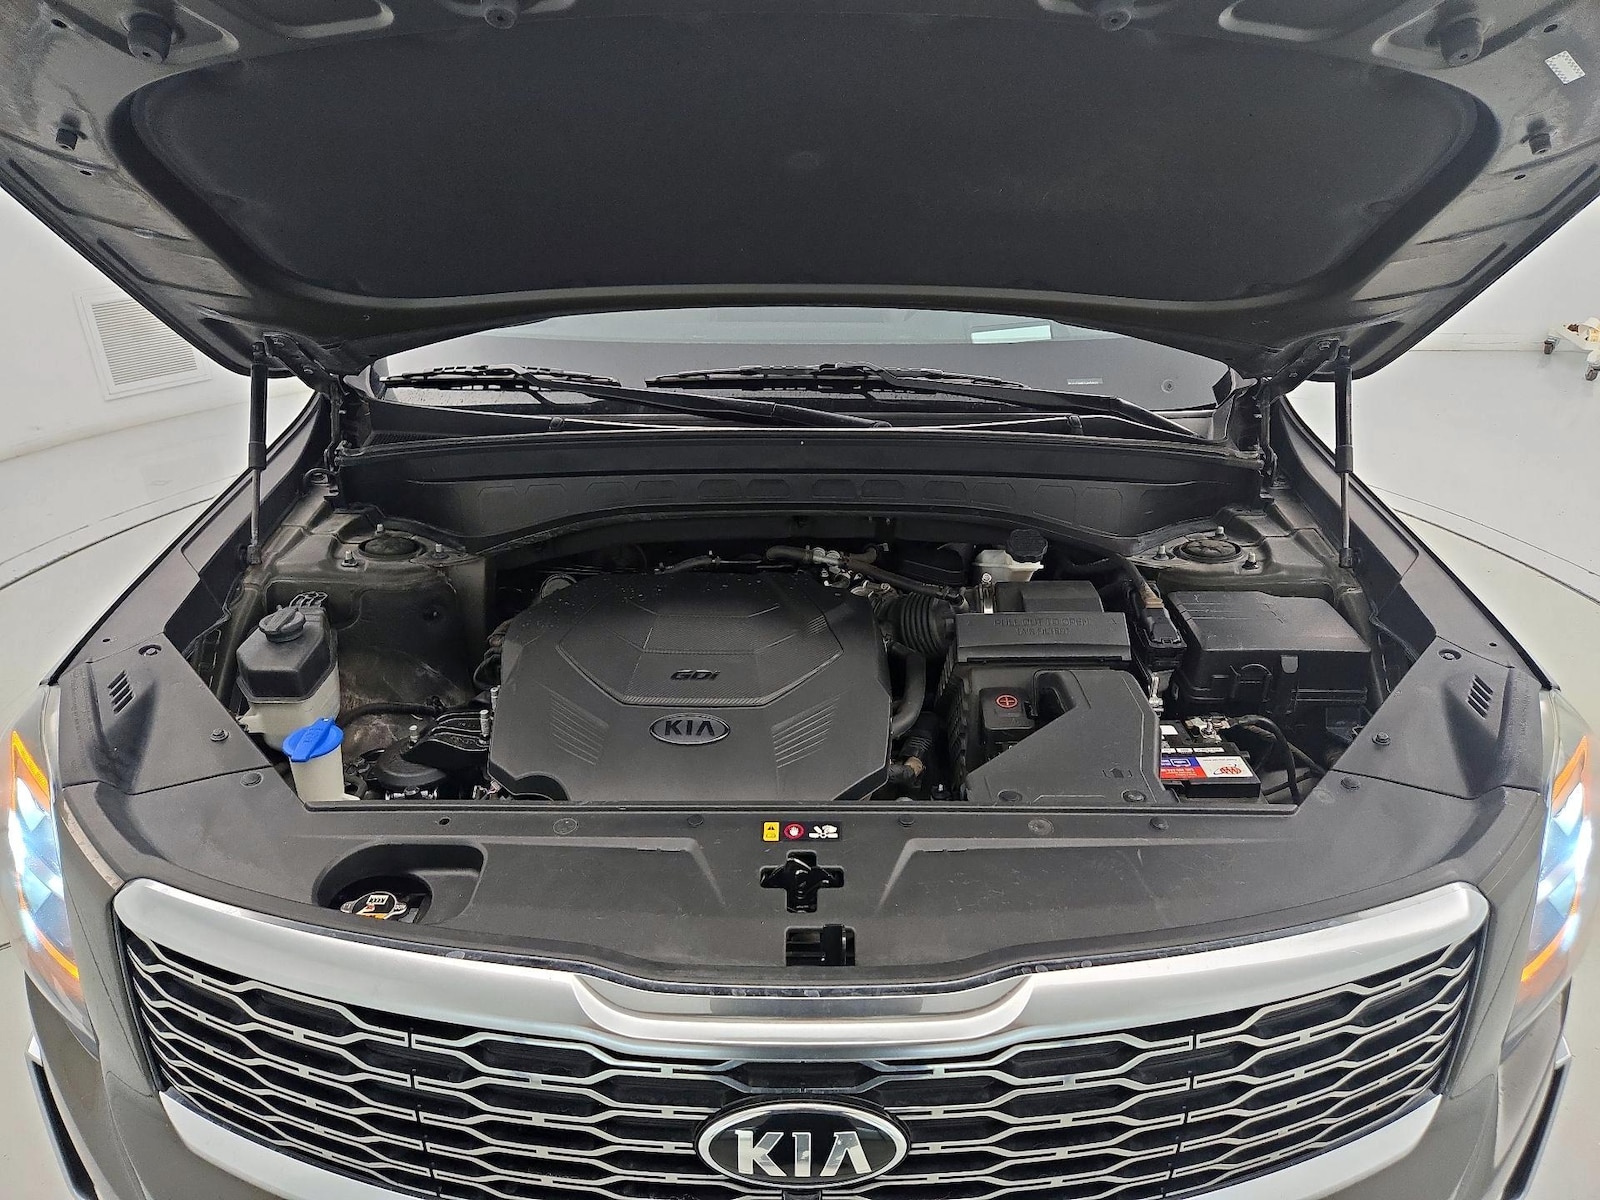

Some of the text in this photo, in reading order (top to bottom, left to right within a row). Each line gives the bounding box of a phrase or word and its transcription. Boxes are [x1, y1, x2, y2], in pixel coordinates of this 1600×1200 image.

[993, 617, 1091, 627] PULL OUT TO OPEN
[664, 720, 715, 736] KIA
[734, 1129, 873, 1177] KIA
